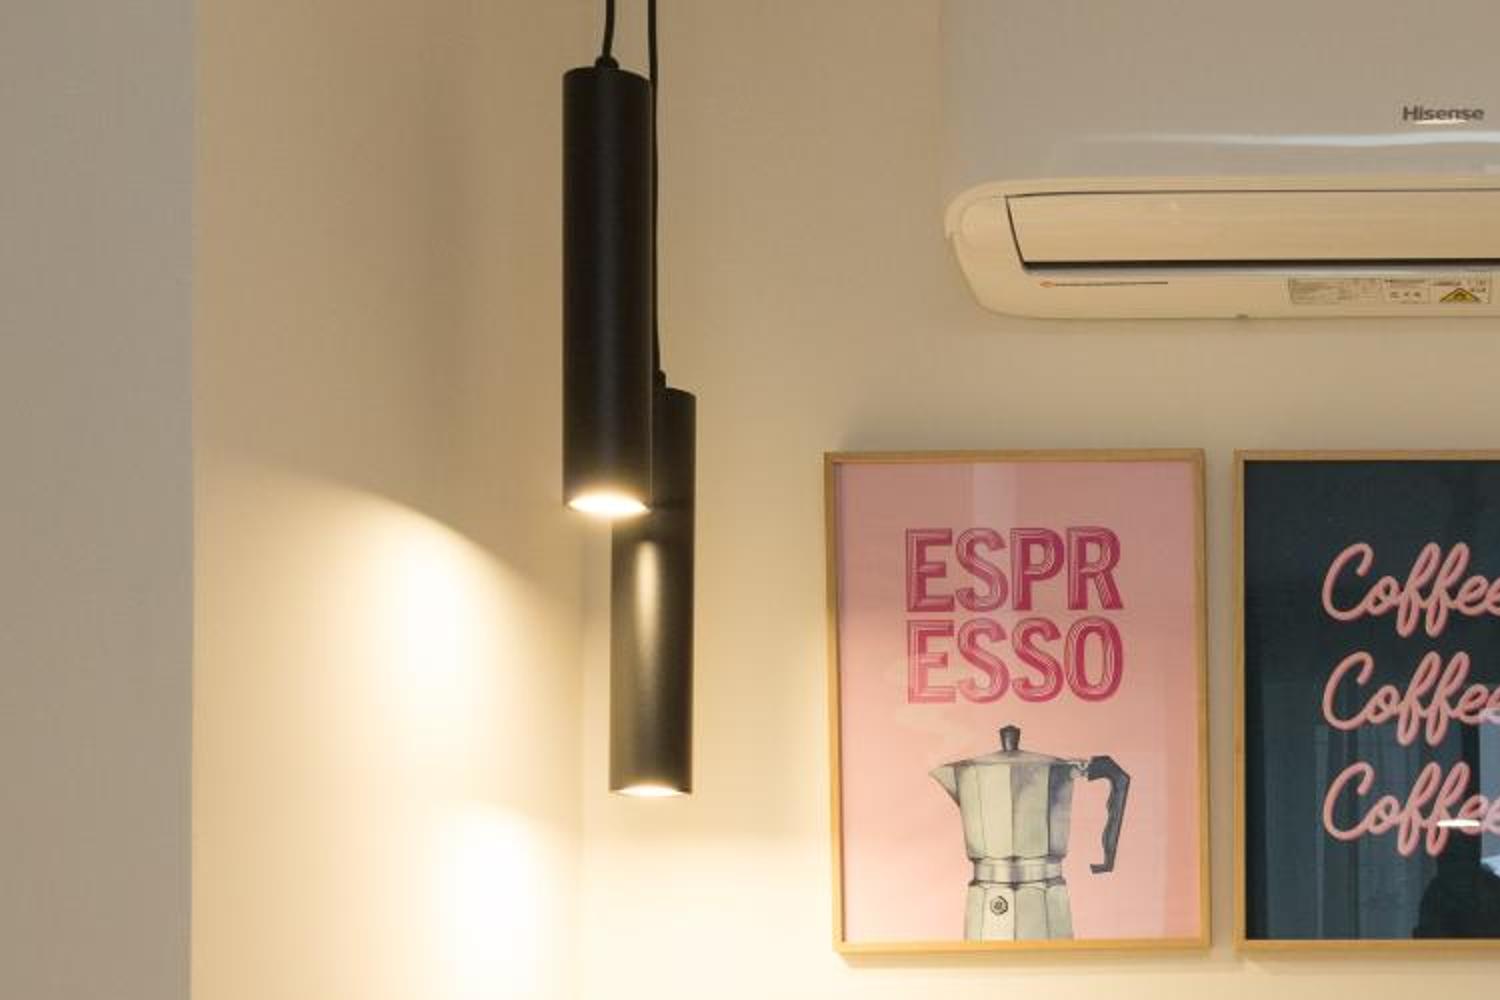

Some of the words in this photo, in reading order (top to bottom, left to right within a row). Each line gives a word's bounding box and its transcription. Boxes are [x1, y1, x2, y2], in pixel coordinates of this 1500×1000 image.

[1403, 105, 1485, 121] Hisense
[905, 526, 1124, 612] ESPR
[907, 617, 1124, 704] ESSO
